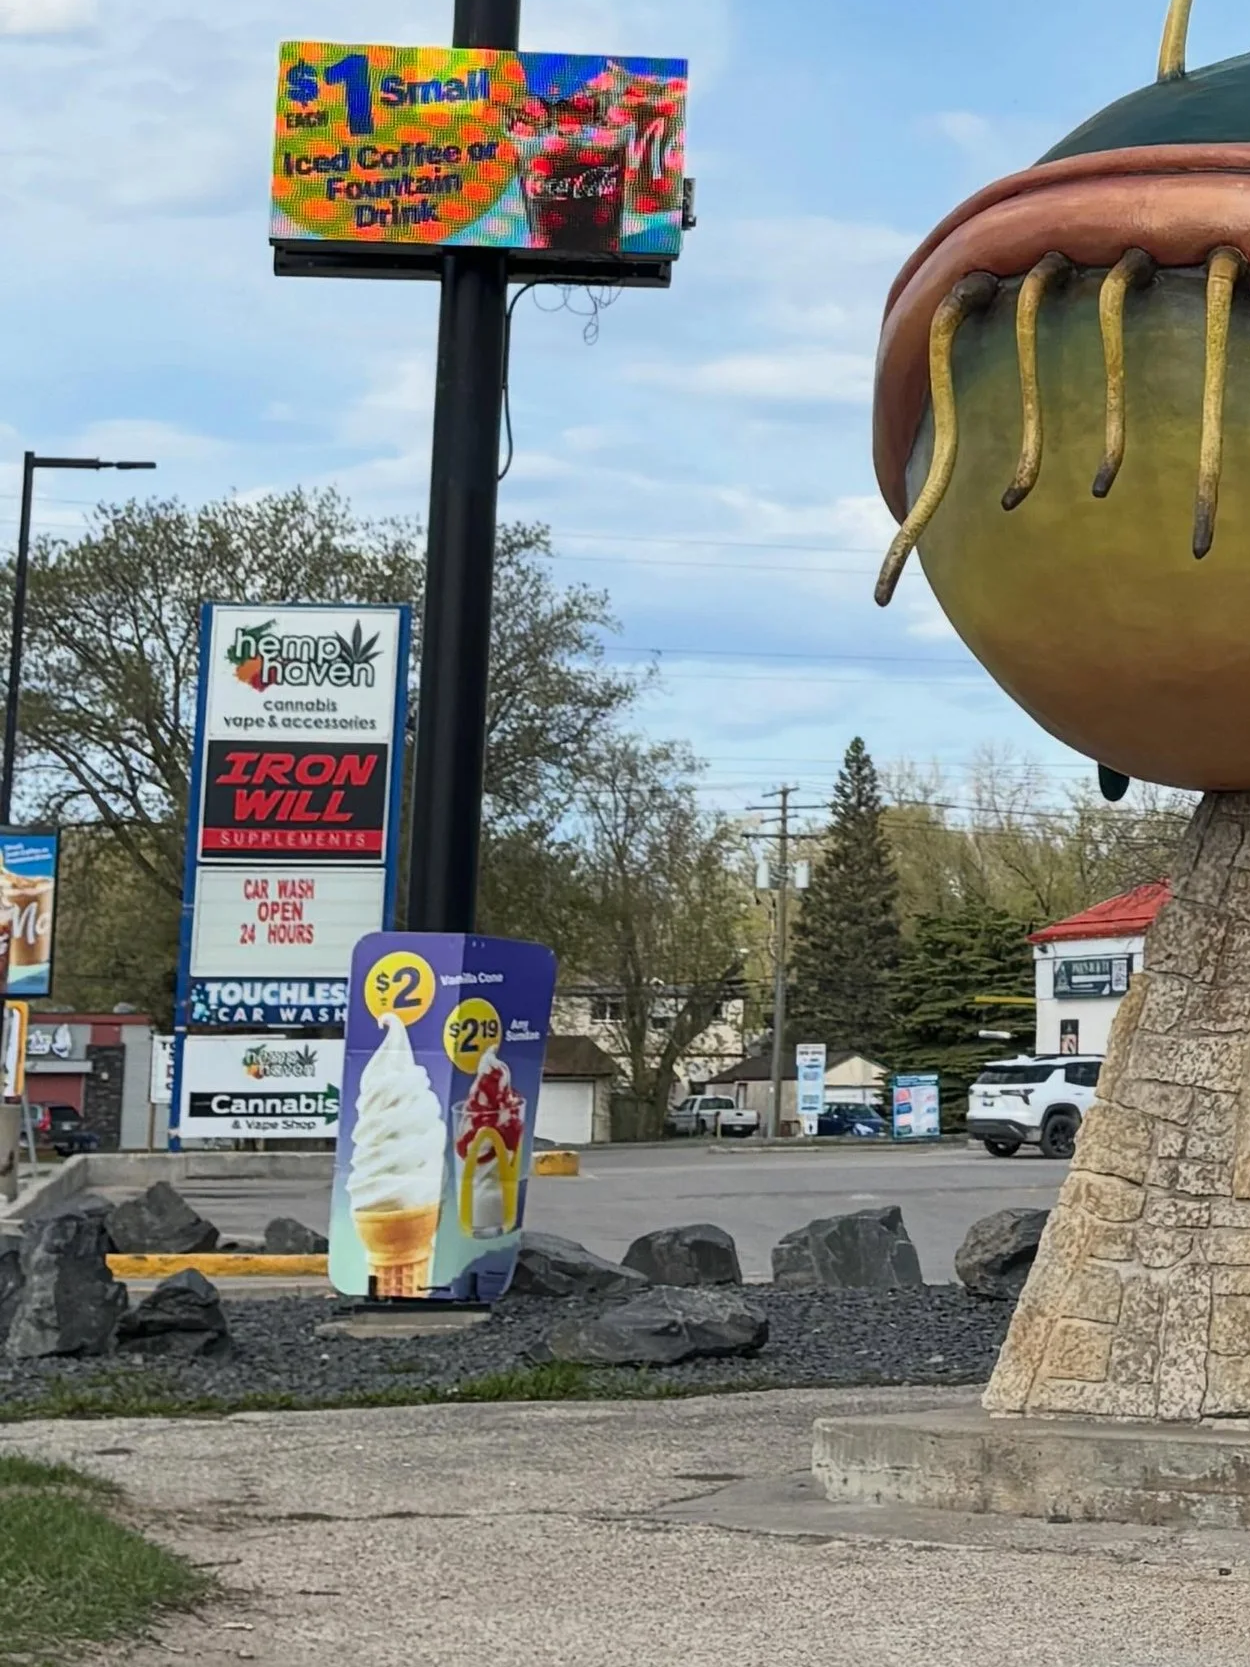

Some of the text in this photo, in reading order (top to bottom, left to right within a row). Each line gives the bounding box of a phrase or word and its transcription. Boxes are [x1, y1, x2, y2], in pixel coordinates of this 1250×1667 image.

[380, 69, 490, 107] Small
[284, 142, 497, 177] Iced Coffee or
[326, 167, 462, 201] Fountain
[355, 199, 438, 228] Drink
[235, 627, 341, 665] hemp
[261, 655, 375, 687] haven
[262, 698, 338, 713] cannabis
[223, 715, 377, 732] vape & accessories
[216, 752, 378, 786] IRON
[234, 789, 353, 821] WILL
[220, 831, 366, 847] SUPPLEMENTS
[243, 878, 315, 900] CAR WASH
[257, 901, 303, 922] OPEN
[240, 923, 314, 945] 24 HOURS
[478, 971, 504, 984] Cone
[205, 982, 347, 1006] TOUCHLES
[217, 1007, 348, 1022] CAR WASH
[510, 1019, 529, 1032] Any
[210, 1093, 340, 1115] Cannabis
[245, 1119, 278, 1132] Vape
[281, 1119, 317, 1131] Shop
